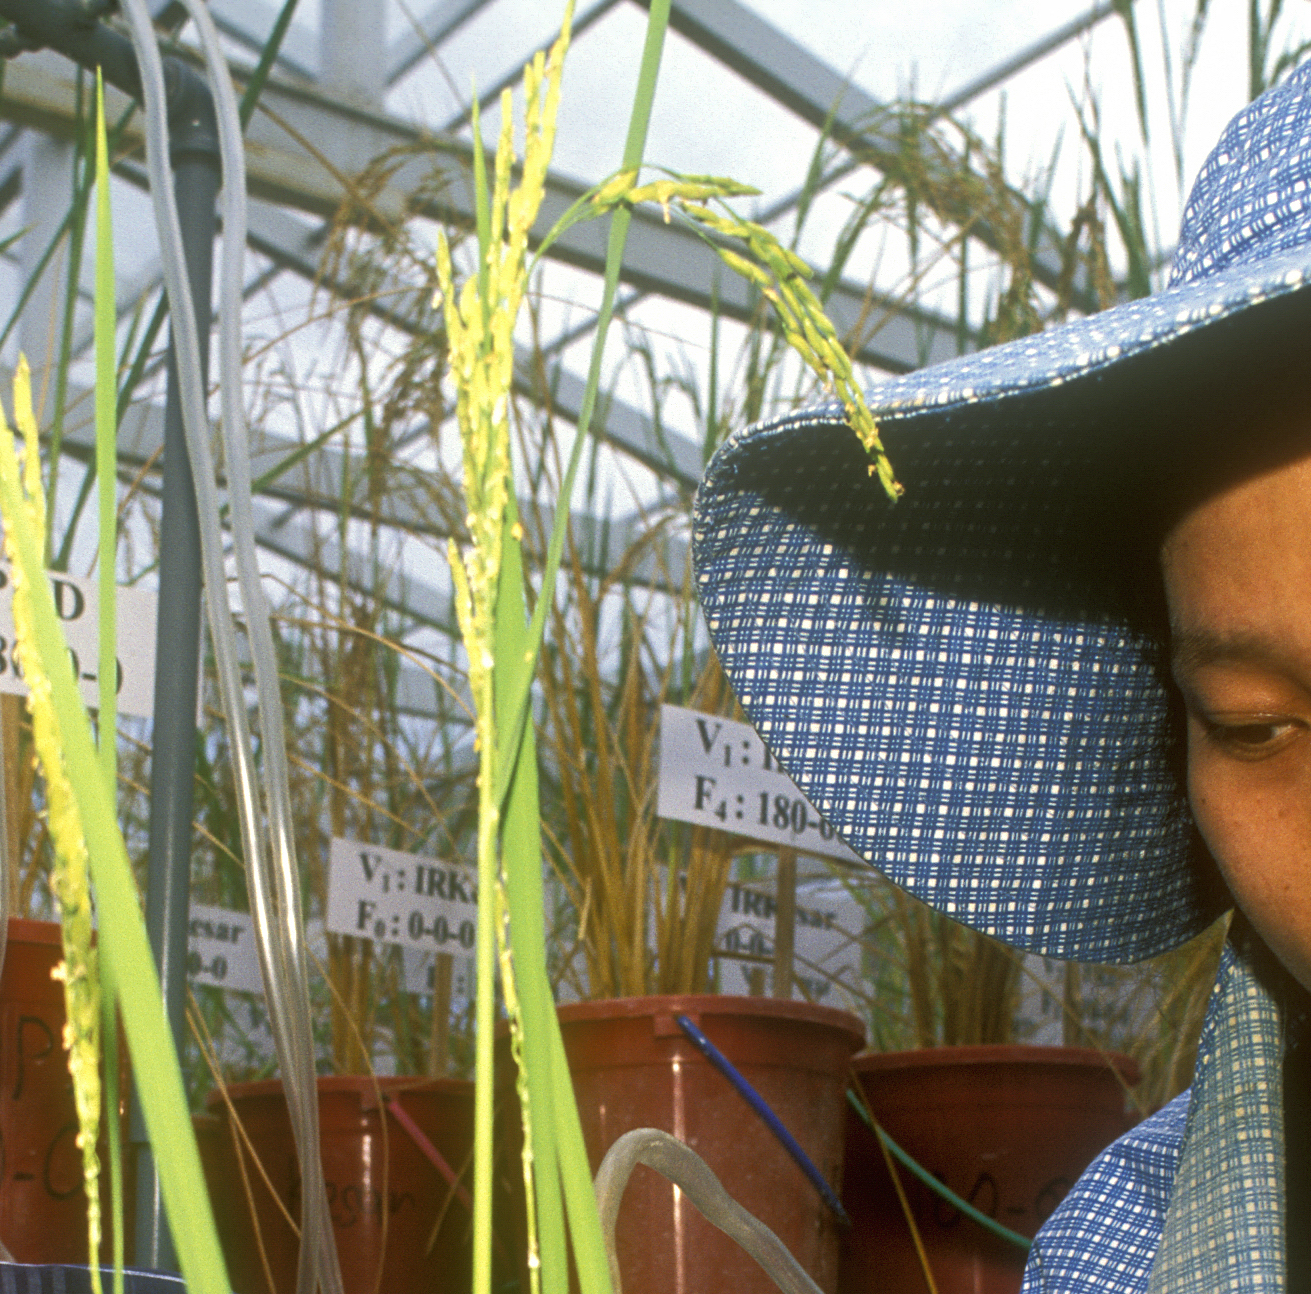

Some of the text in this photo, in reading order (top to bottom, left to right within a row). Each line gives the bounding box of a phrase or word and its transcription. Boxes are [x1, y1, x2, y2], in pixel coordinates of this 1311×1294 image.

[758, 791, 847, 844] 180-0
[189, 918, 245, 944] esar
[408, 911, 476, 949] 0-0-0
[187, 950, 229, 981] 0-0
